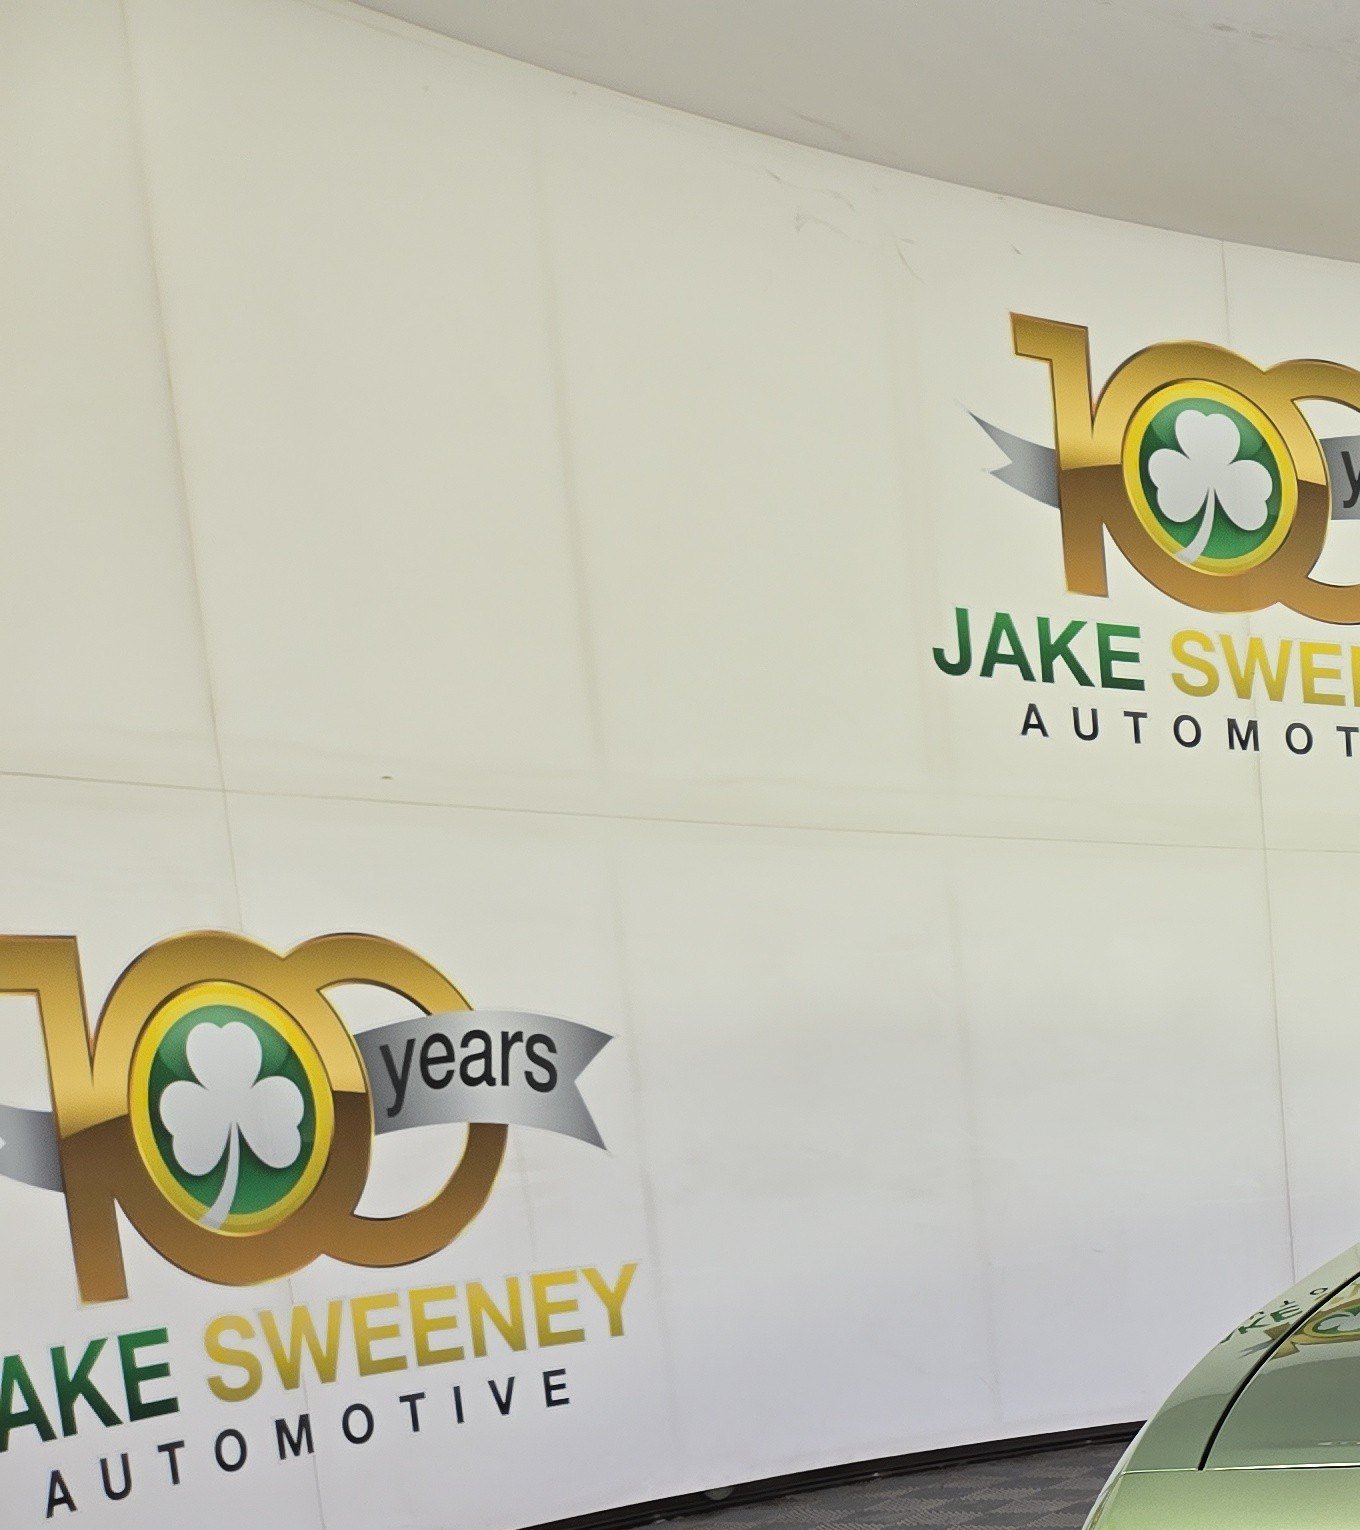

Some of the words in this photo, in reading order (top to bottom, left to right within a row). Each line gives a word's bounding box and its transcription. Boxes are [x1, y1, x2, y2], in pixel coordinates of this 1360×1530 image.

[933, 606, 1145, 691] JAKE
[380, 1028, 559, 1117] years
[203, 1263, 638, 1402] SWEENEY
[46, 1369, 570, 1518] AUTOMOTIVE
